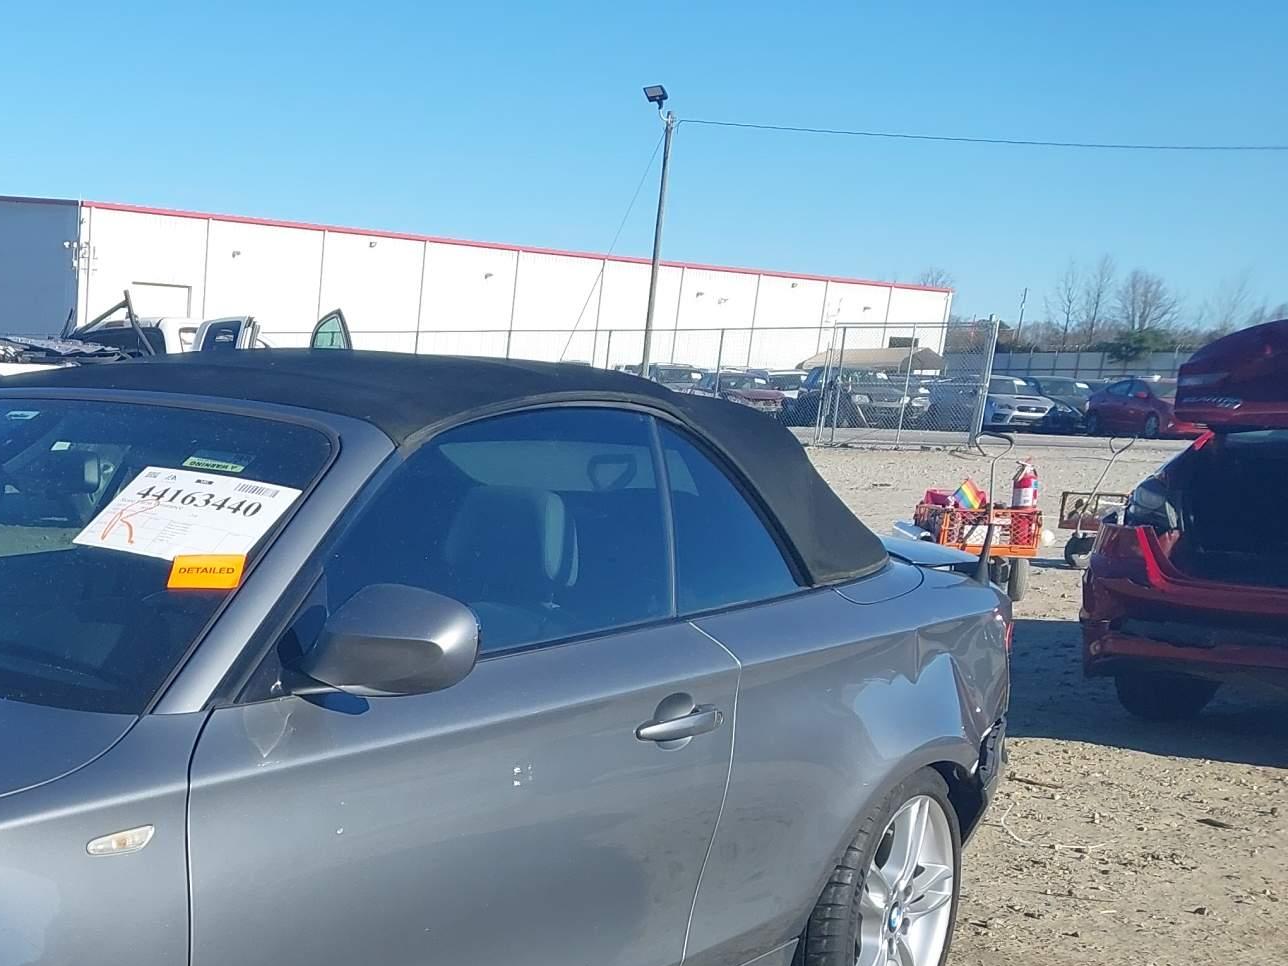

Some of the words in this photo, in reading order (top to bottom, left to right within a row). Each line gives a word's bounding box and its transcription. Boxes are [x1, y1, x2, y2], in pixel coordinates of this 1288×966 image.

[189, 460, 229, 470] WARNING
[137, 485, 262, 517] 44163440
[178, 566, 235, 575] DETAILED
